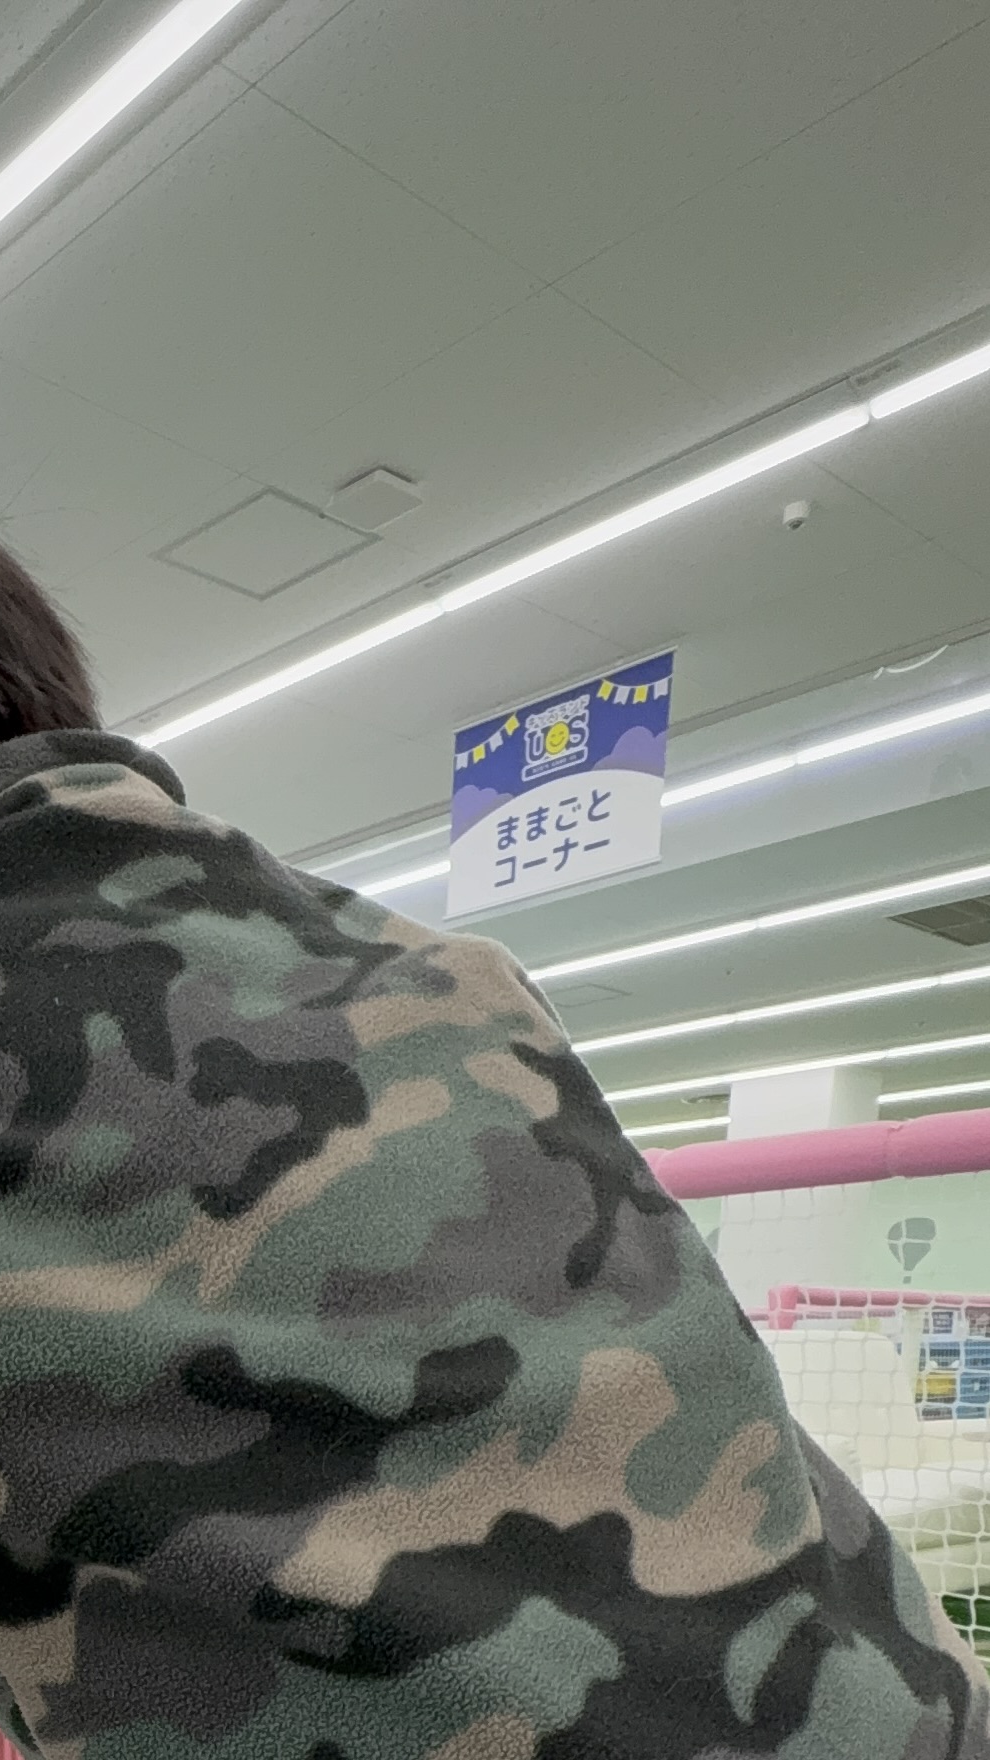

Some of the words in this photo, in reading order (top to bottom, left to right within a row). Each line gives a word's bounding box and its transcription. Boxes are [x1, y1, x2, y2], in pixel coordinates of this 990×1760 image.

[496, 789, 611, 850] ままごと
[494, 838, 610, 888] コーナー
